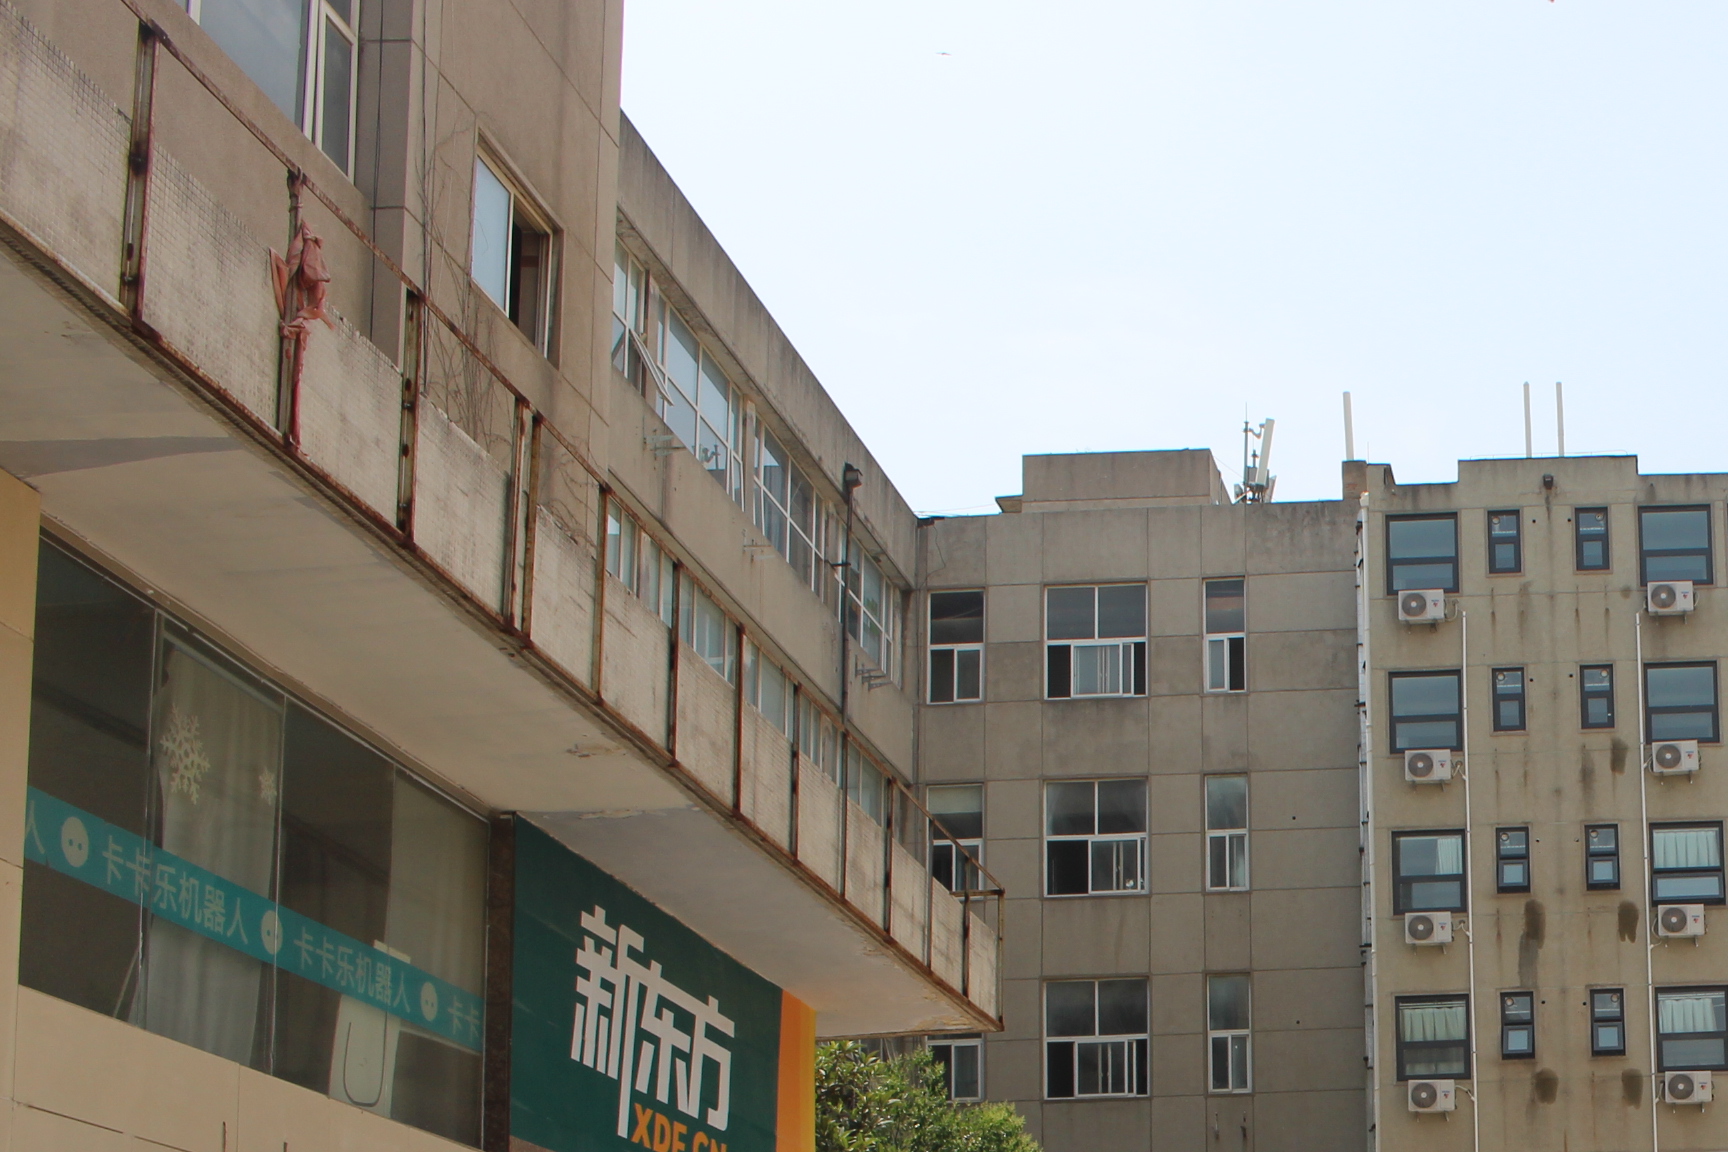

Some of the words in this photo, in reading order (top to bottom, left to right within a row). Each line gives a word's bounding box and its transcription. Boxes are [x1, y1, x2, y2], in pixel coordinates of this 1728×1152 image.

[102, 834, 249, 945] 卡卡乐机器人
[293, 926, 411, 1014] 卡卡乐机器人
[448, 995, 481, 1043] 卡卡
[570, 904, 735, 1139] 新东方
